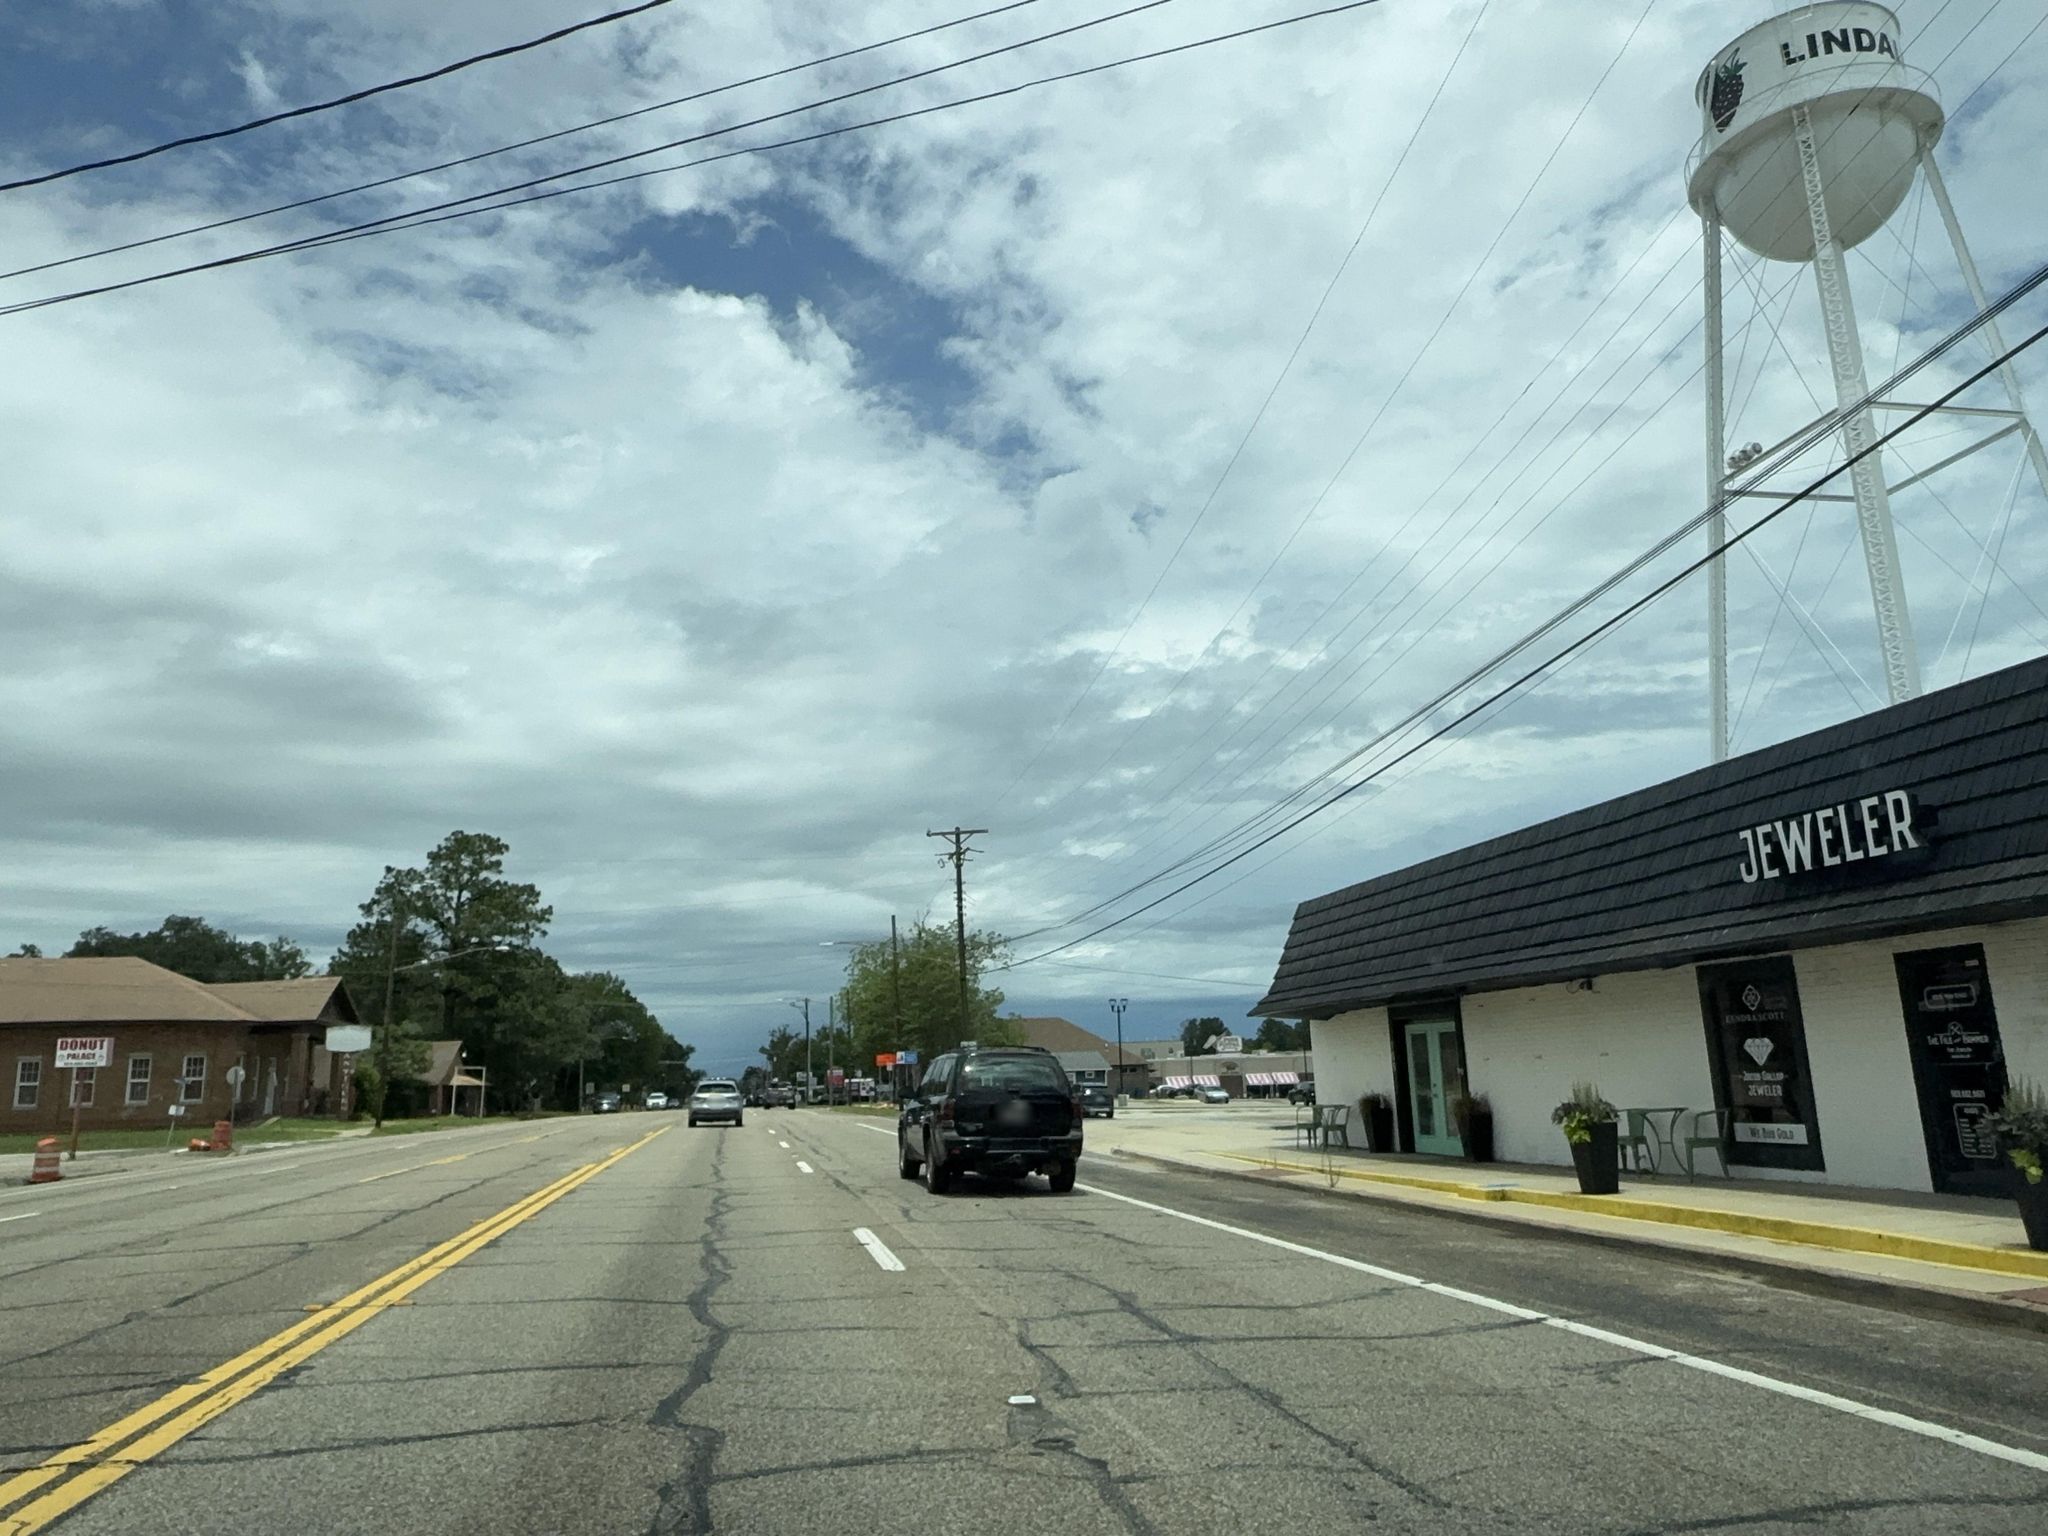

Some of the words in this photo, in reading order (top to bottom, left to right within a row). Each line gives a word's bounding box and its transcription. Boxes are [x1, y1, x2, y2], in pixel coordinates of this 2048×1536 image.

[1738, 789, 1921, 884] JEWELER
[59, 1039, 106, 1051] DONUT
[66, 1052, 96, 1060] PALACE
[1748, 1085, 1783, 1096] JEWELER
